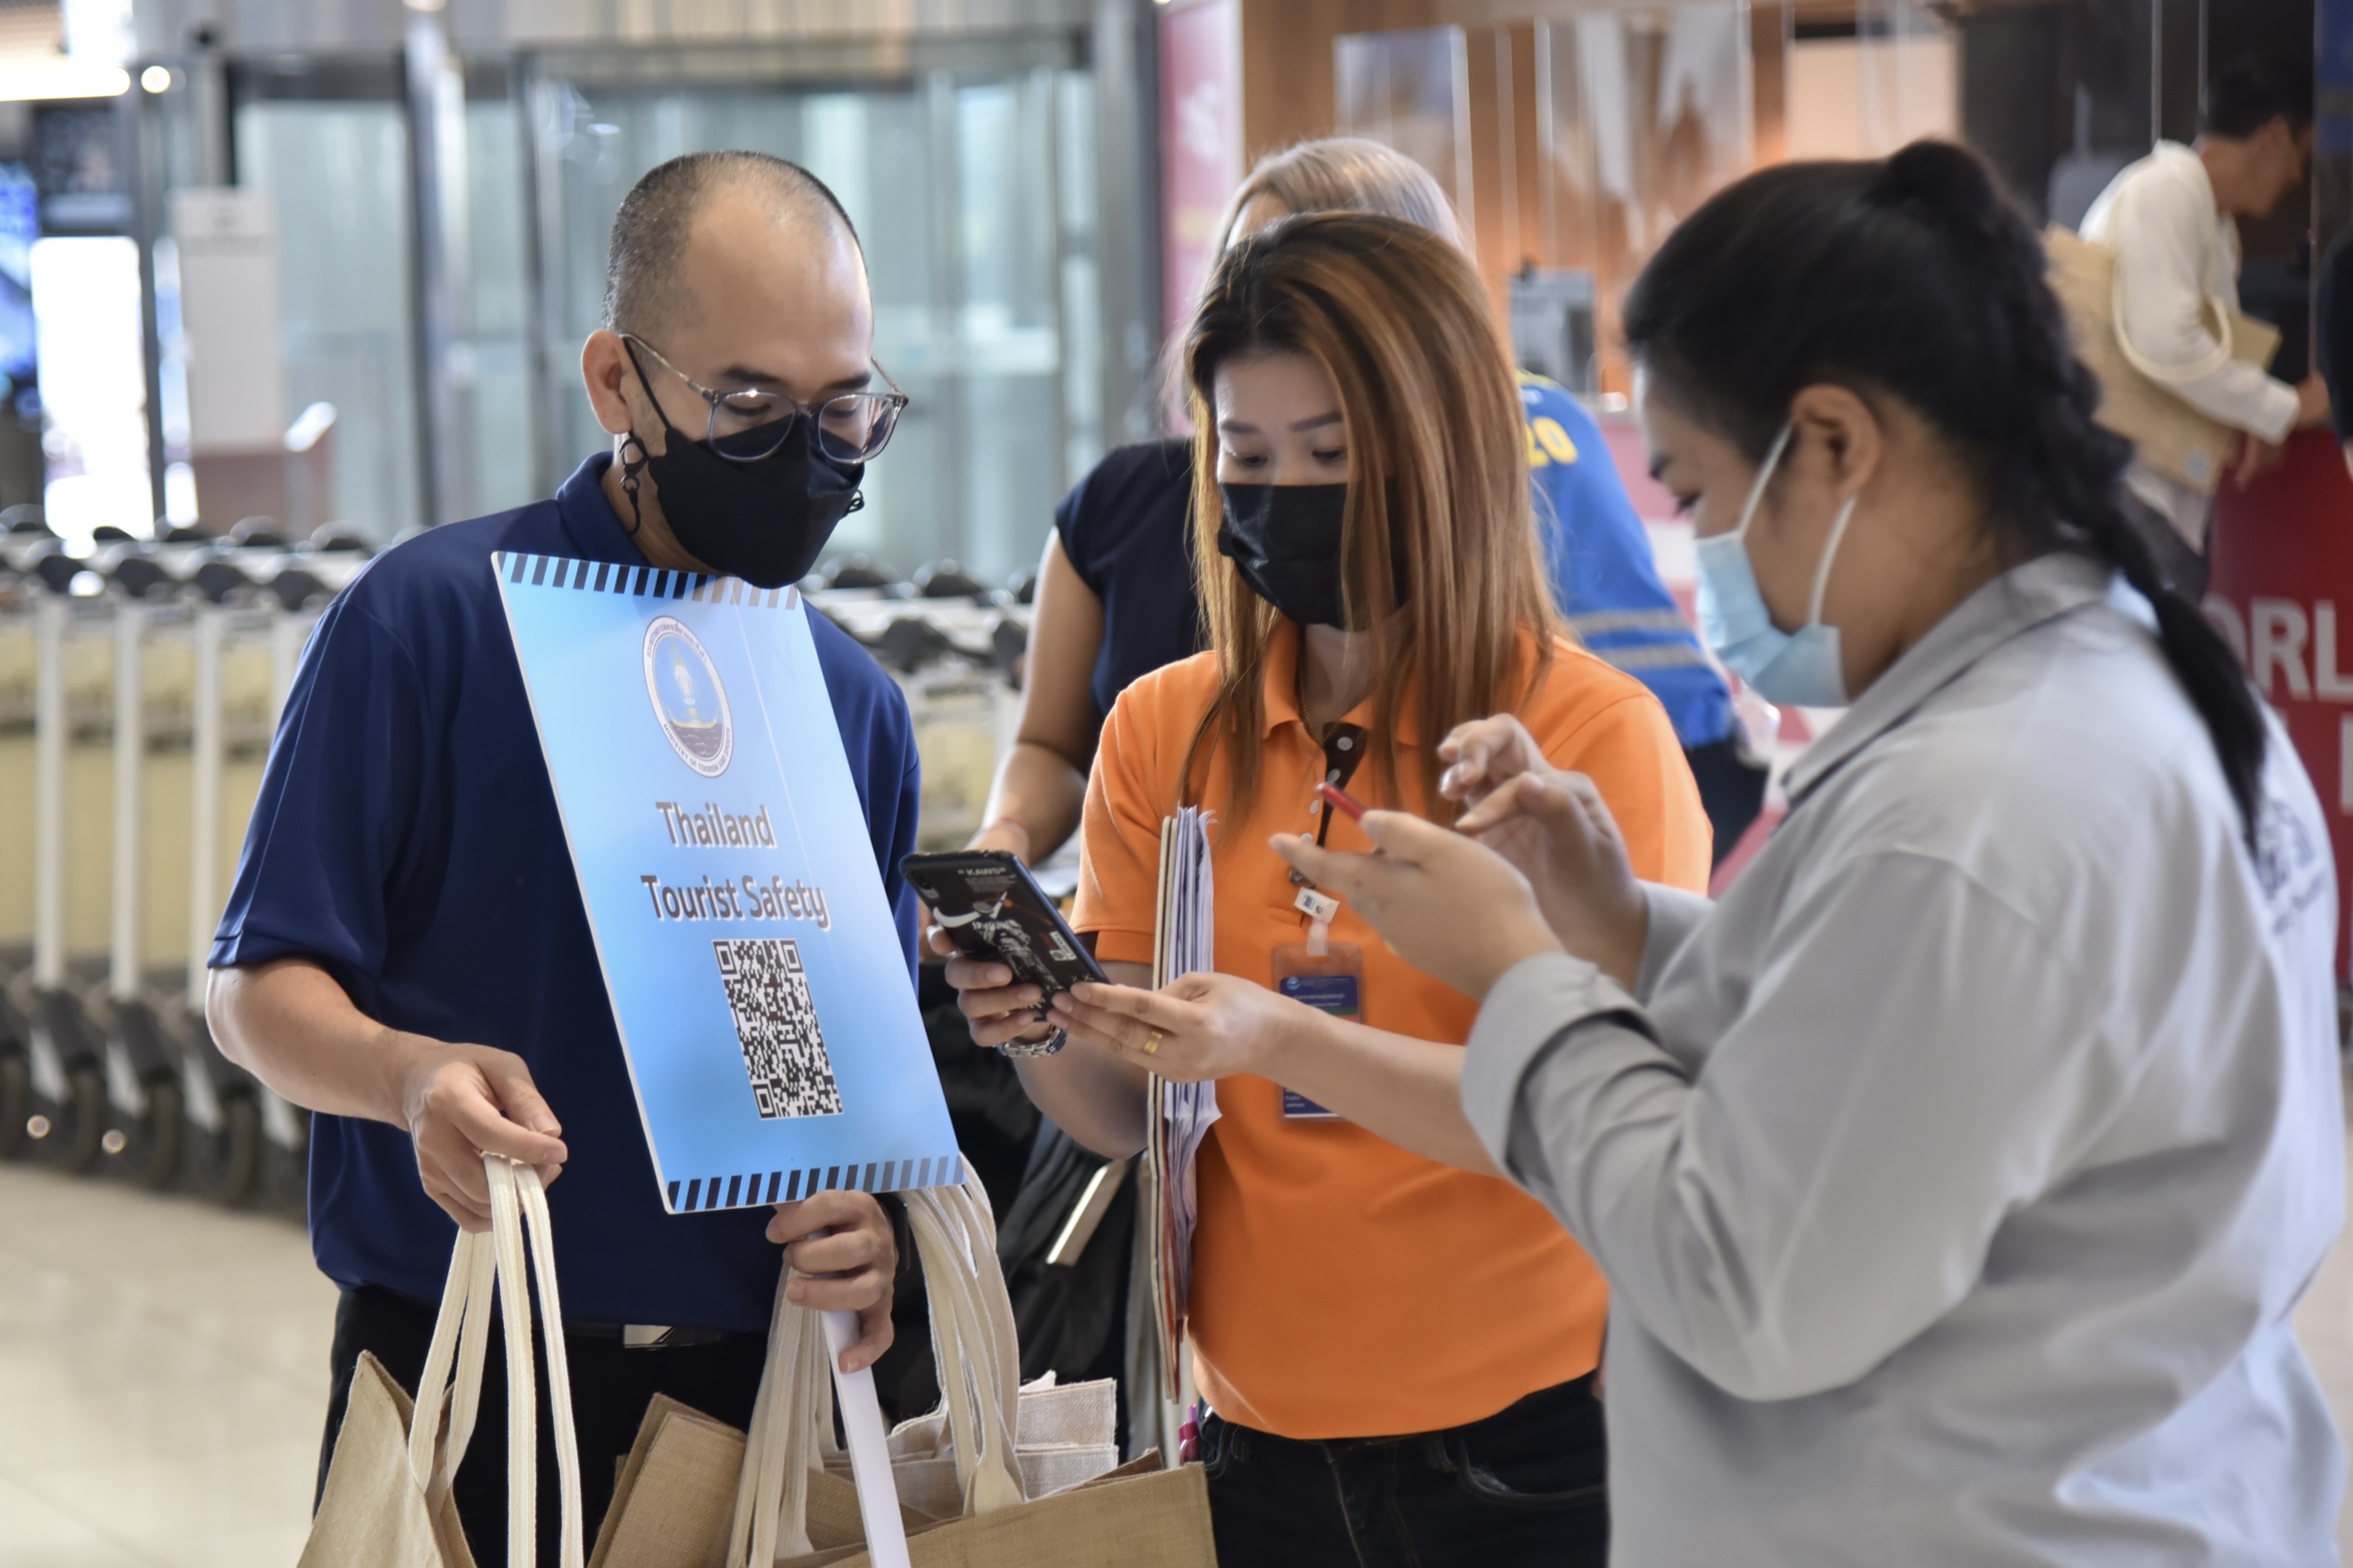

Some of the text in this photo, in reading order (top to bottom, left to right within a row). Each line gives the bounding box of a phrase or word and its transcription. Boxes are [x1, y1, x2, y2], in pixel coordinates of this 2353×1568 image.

[656, 801, 777, 848] Thailand
[641, 875, 831, 931] Tourist Safety
